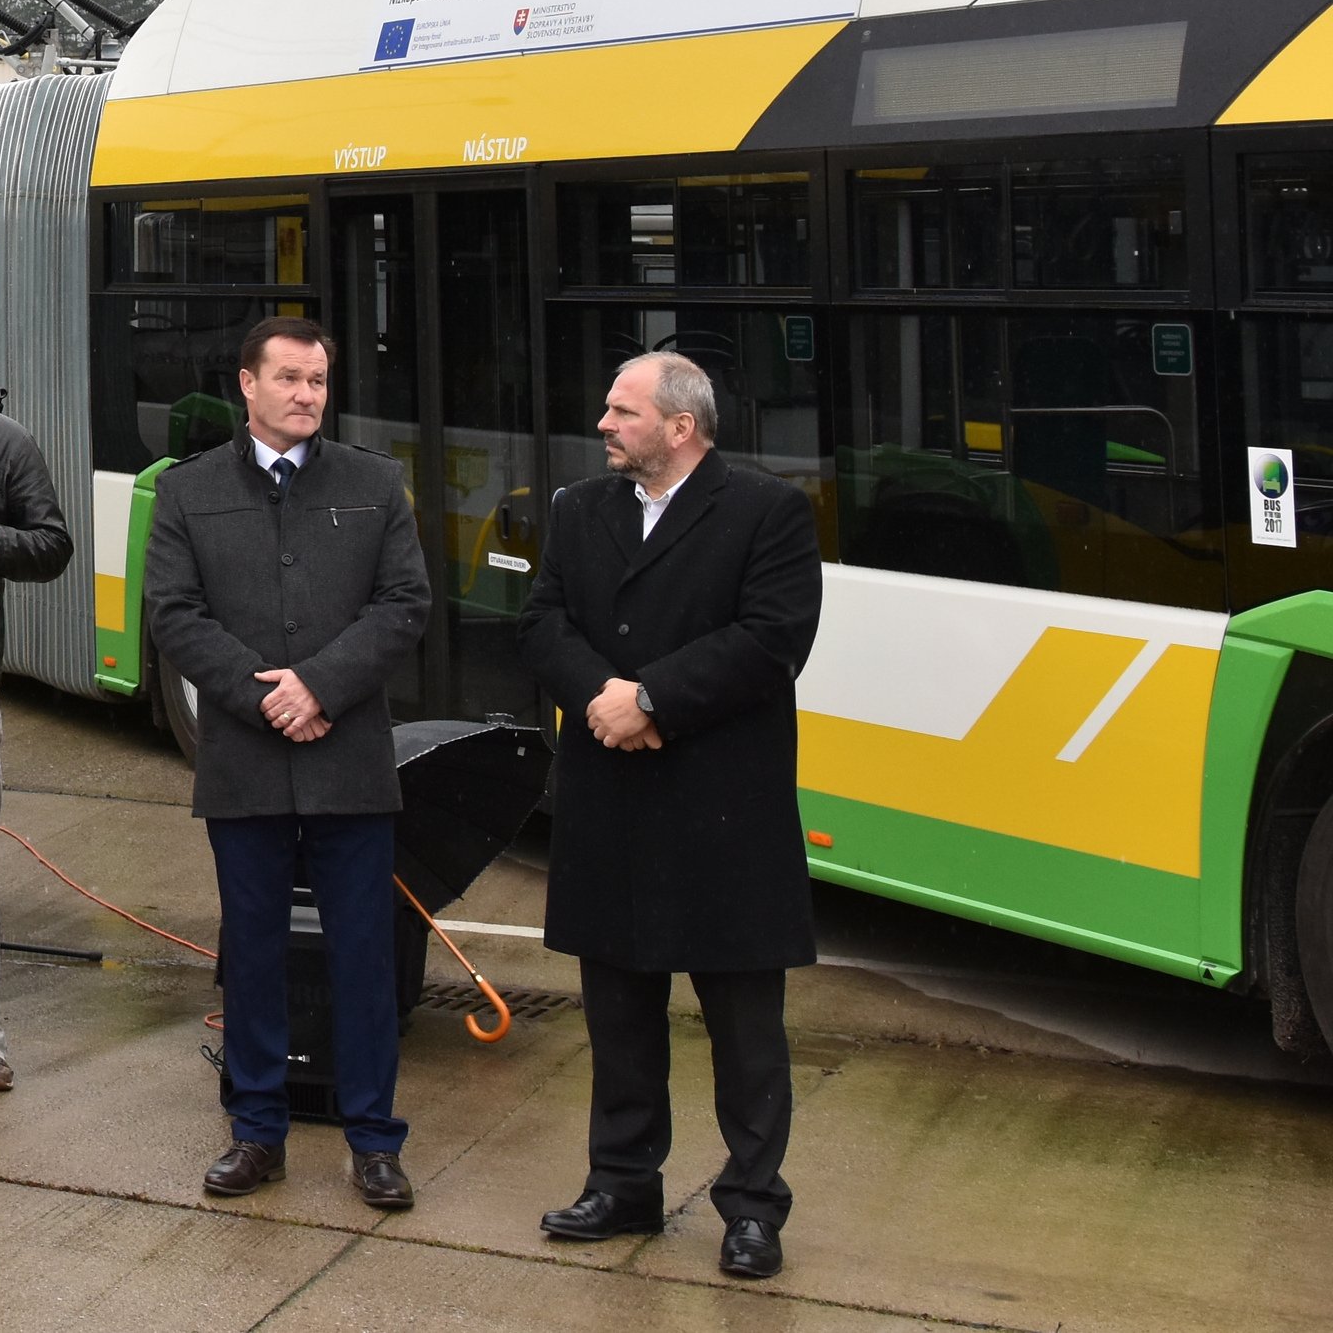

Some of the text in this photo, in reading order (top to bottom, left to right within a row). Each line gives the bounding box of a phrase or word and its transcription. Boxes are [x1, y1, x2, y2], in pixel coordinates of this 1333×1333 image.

[532, 3, 576, 15] MINISTERSTVO
[528, 19, 557, 29] DOPRAVY
[463, 133, 528, 162] NÁSTUP
[334, 143, 387, 169] VÝSTUP
[1264, 499, 1281, 511] BUS
[1264, 518, 1282, 533] 2017
